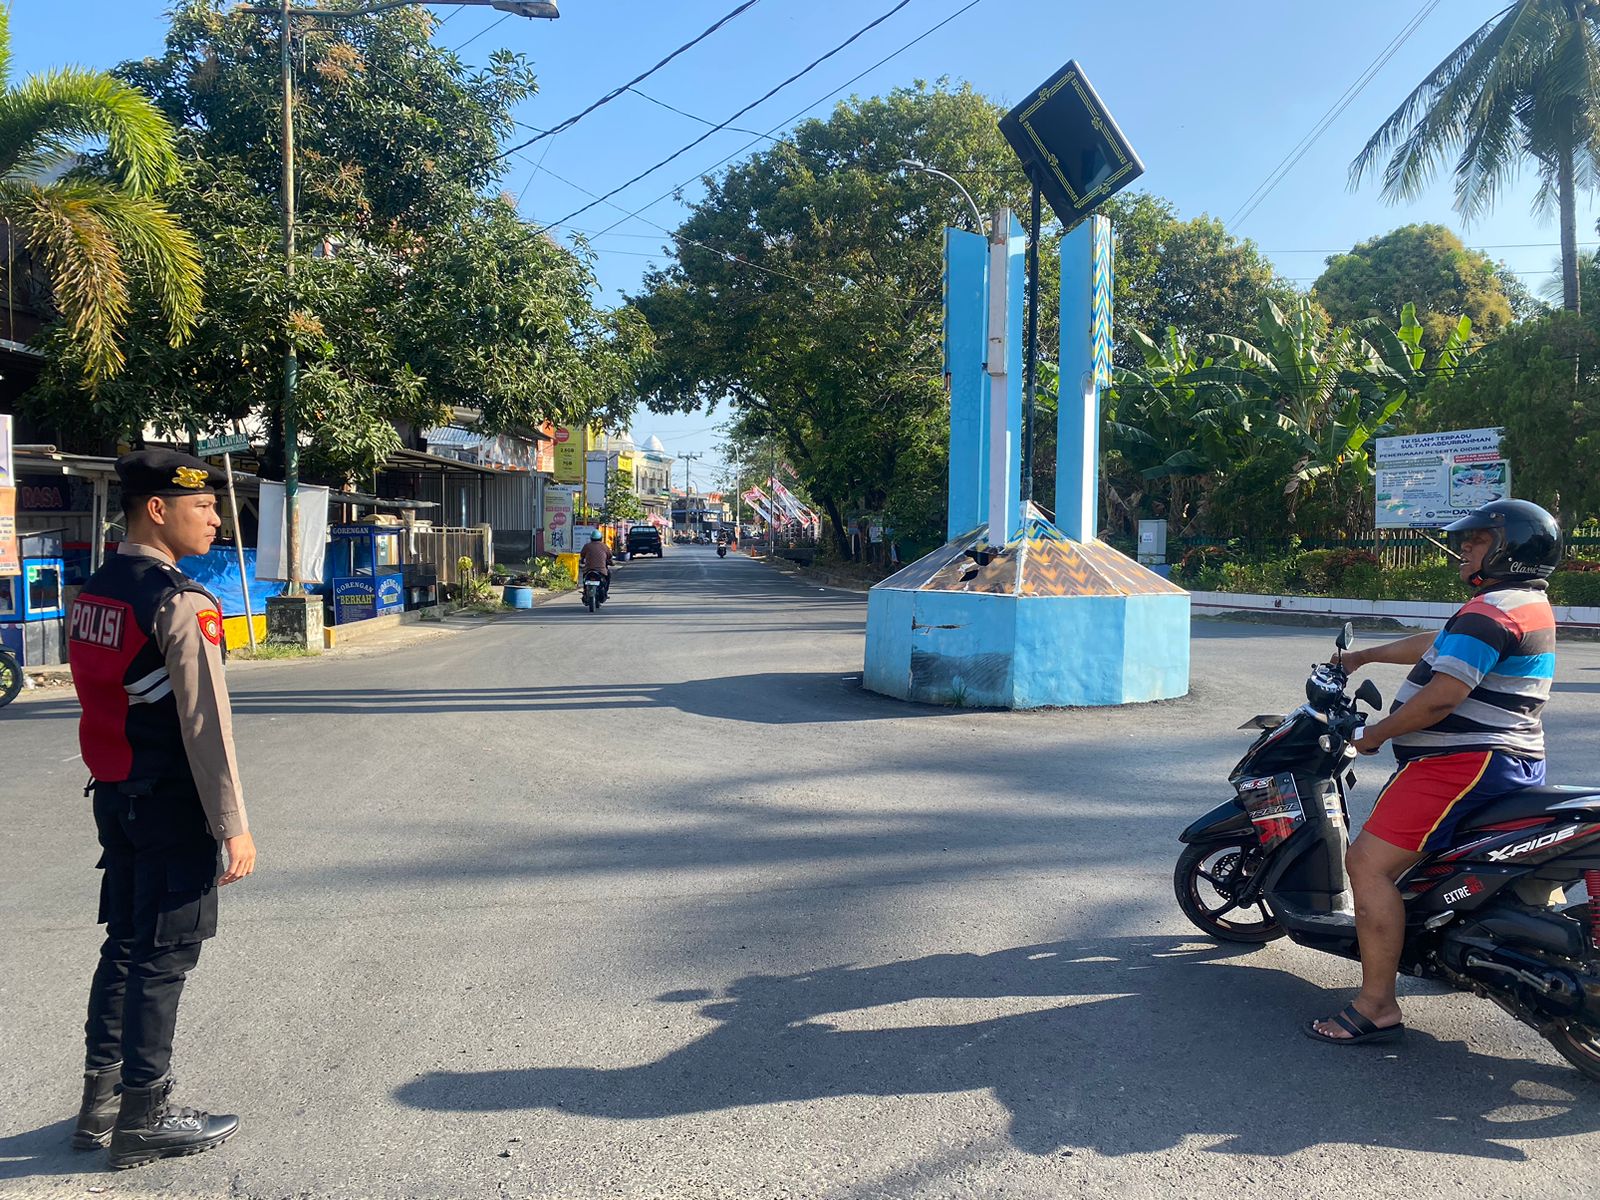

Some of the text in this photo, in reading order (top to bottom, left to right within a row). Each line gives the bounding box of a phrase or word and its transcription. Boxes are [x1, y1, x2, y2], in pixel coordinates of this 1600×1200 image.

[207, 436, 220, 449] ANDI
[22, 486, 62, 508] RASA
[1510, 561, 1539, 574] Classic
[336, 581, 374, 594] GORENGAN
[70, 602, 122, 648] POLISI
[1488, 824, 1578, 862] X-RIDE
